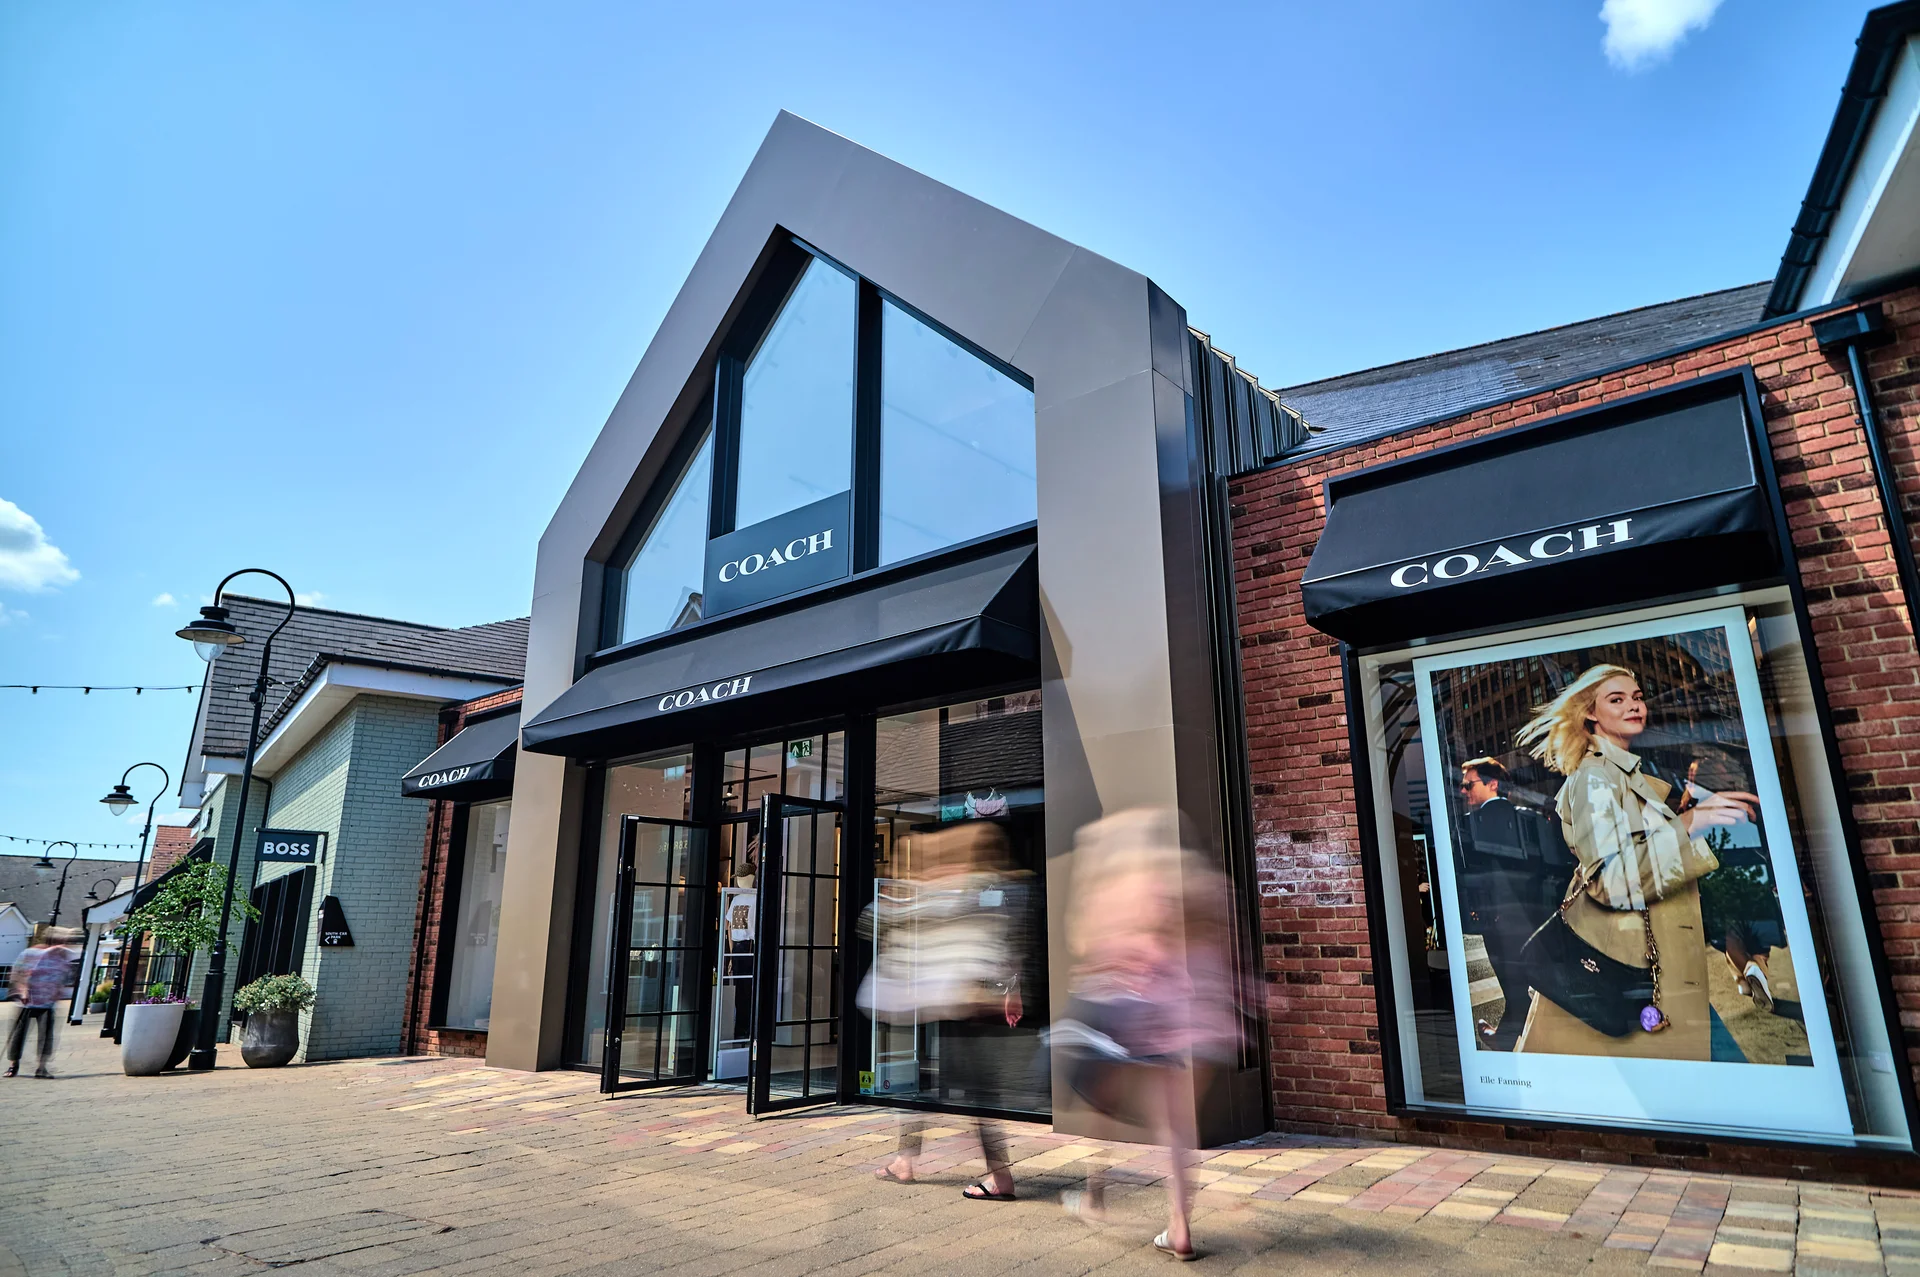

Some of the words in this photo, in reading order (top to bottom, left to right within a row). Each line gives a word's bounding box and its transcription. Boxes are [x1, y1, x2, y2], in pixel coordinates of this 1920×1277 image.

[718, 528, 834, 583] COACH
[1389, 517, 1635, 589] COACH
[657, 675, 753, 712] COACH
[417, 766, 471, 789] COACH
[263, 841, 310, 856] BOSS
[1480, 1076, 1495, 1084] Elle
[1497, 1077, 1532, 1088] Fanning
